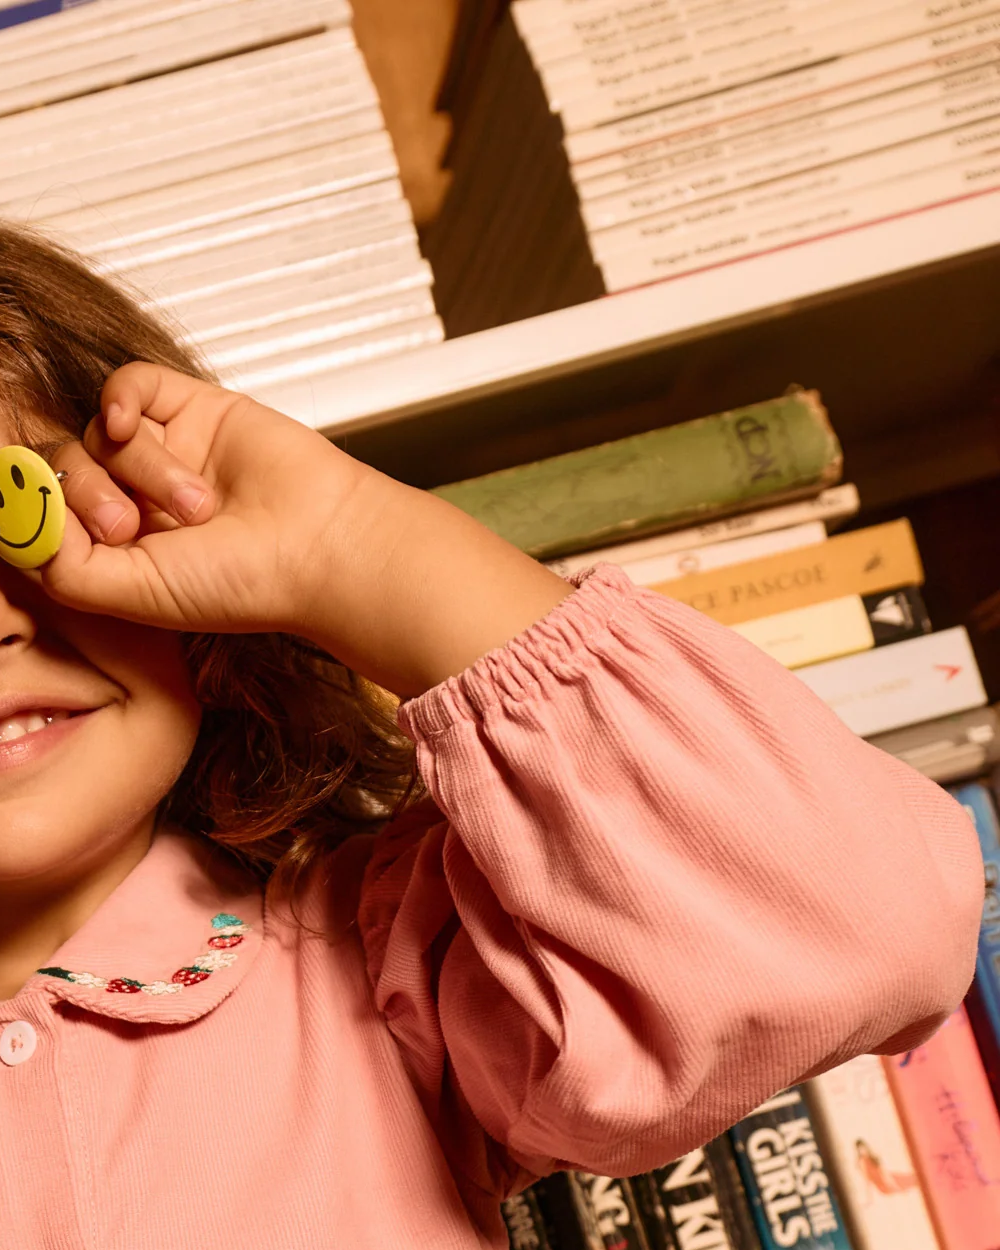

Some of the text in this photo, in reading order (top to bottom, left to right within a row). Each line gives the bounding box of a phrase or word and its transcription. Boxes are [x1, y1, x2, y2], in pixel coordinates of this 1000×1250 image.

[583, 1173, 631, 1235] NG
[747, 1127, 811, 1249] GIRLS
[779, 1117, 839, 1236] KISS THE
